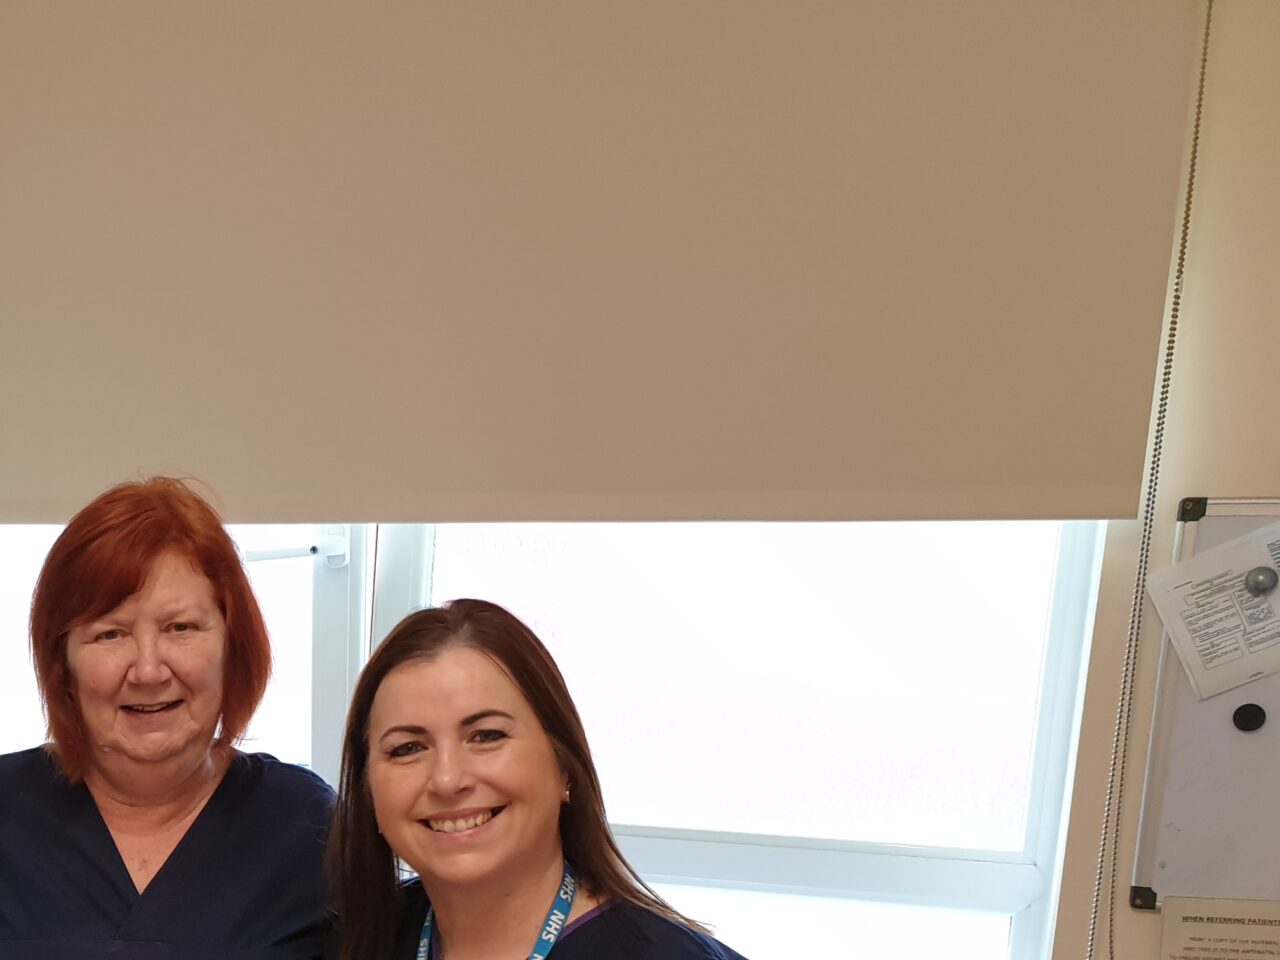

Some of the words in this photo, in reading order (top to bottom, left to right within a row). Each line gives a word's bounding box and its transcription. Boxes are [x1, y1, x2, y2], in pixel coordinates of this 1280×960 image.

[560, 873, 574, 902] NHS
[541, 909, 565, 942] NHS
[1182, 915, 1204, 923] WHEN
[1206, 916, 1245, 925] REFERRING
